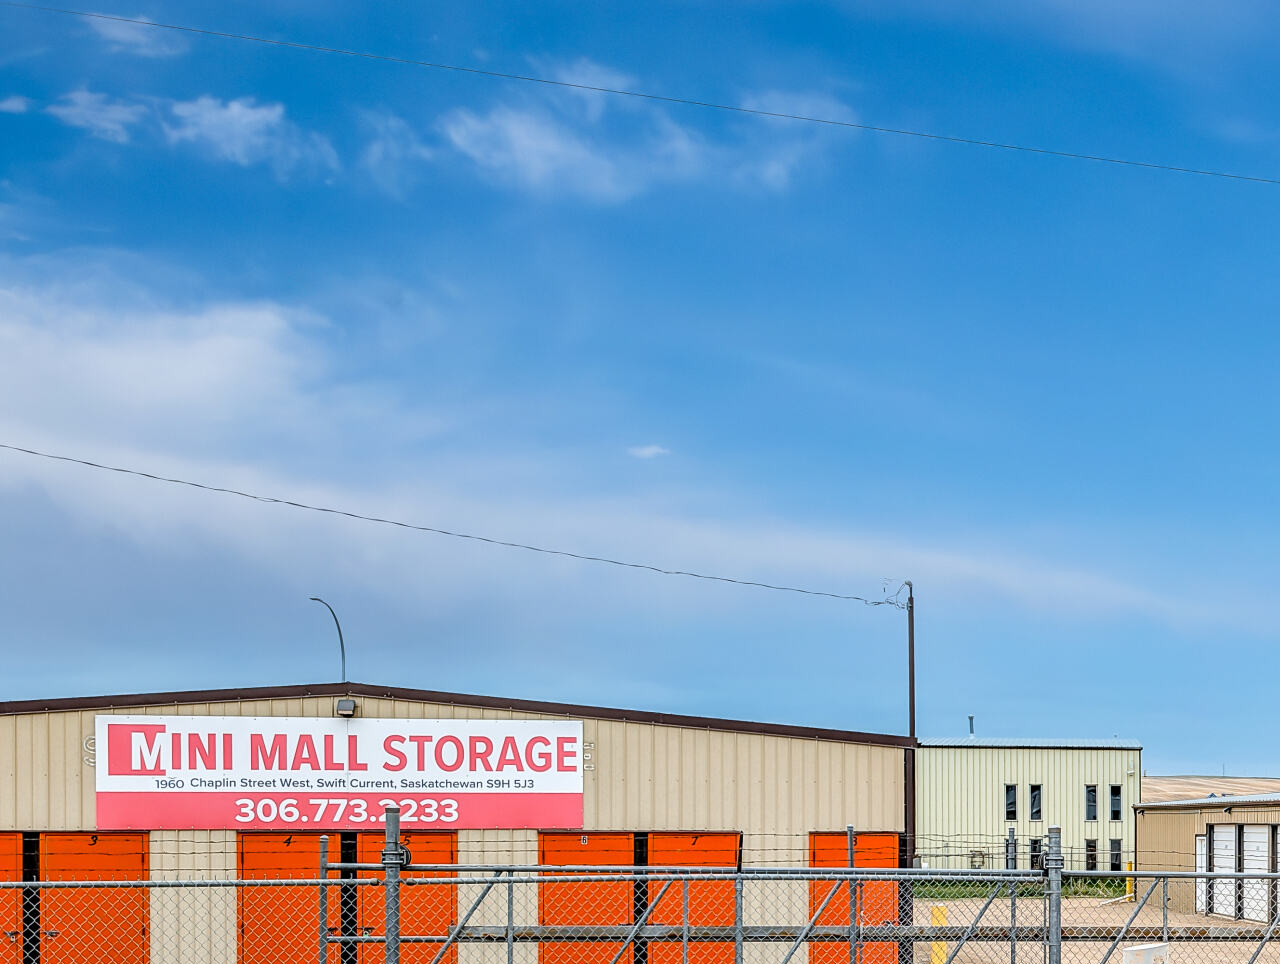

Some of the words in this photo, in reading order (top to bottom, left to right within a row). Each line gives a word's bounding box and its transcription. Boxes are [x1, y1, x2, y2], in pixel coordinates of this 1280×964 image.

[131, 731, 233, 770] MINI
[250, 733, 368, 771] MALL
[382, 734, 578, 773] STORAGE
[155, 779, 184, 789] 1960
[190, 778, 236, 789] Chaplin
[240, 778, 276, 788] Street
[280, 778, 313, 789] West,
[316, 778, 347, 788] Swift
[350, 778, 397, 790] Current,
[400, 779, 483, 789] Saskatchewan
[486, 779, 510, 789] S9H
[514, 779, 535, 789] 5J3
[234, 798, 459, 823] 306.773.2233
